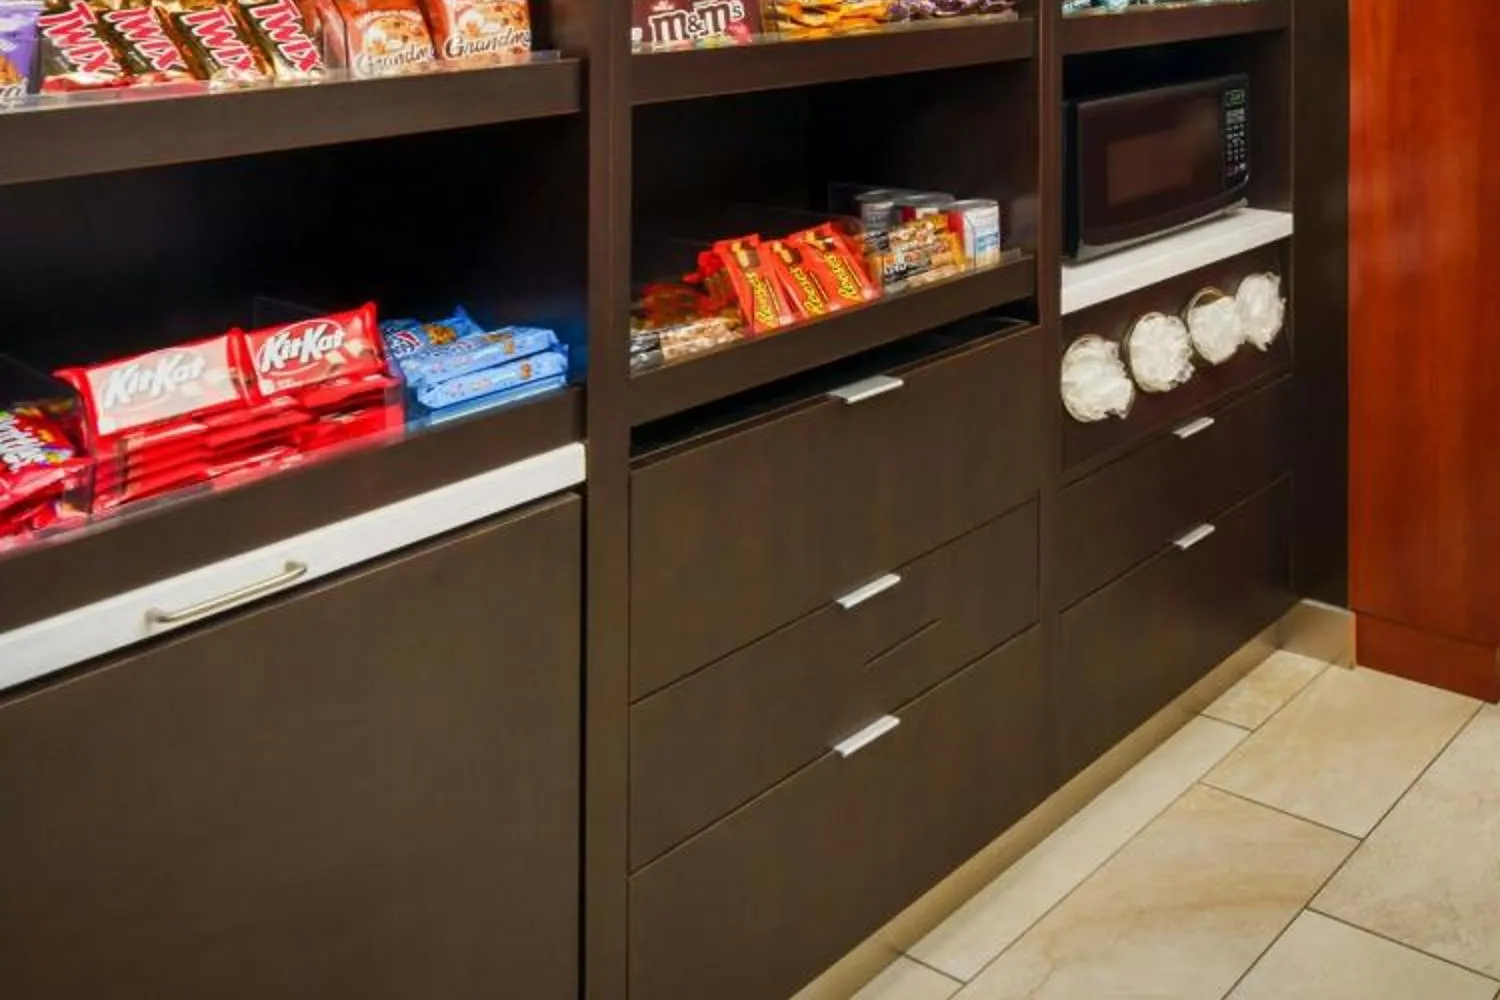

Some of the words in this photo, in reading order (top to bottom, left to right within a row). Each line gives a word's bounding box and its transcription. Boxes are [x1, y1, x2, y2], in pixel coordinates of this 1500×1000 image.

[37, 0, 122, 73] TWIX
[103, 6, 188, 71] TWIX
[181, 4, 263, 83] TWIX
